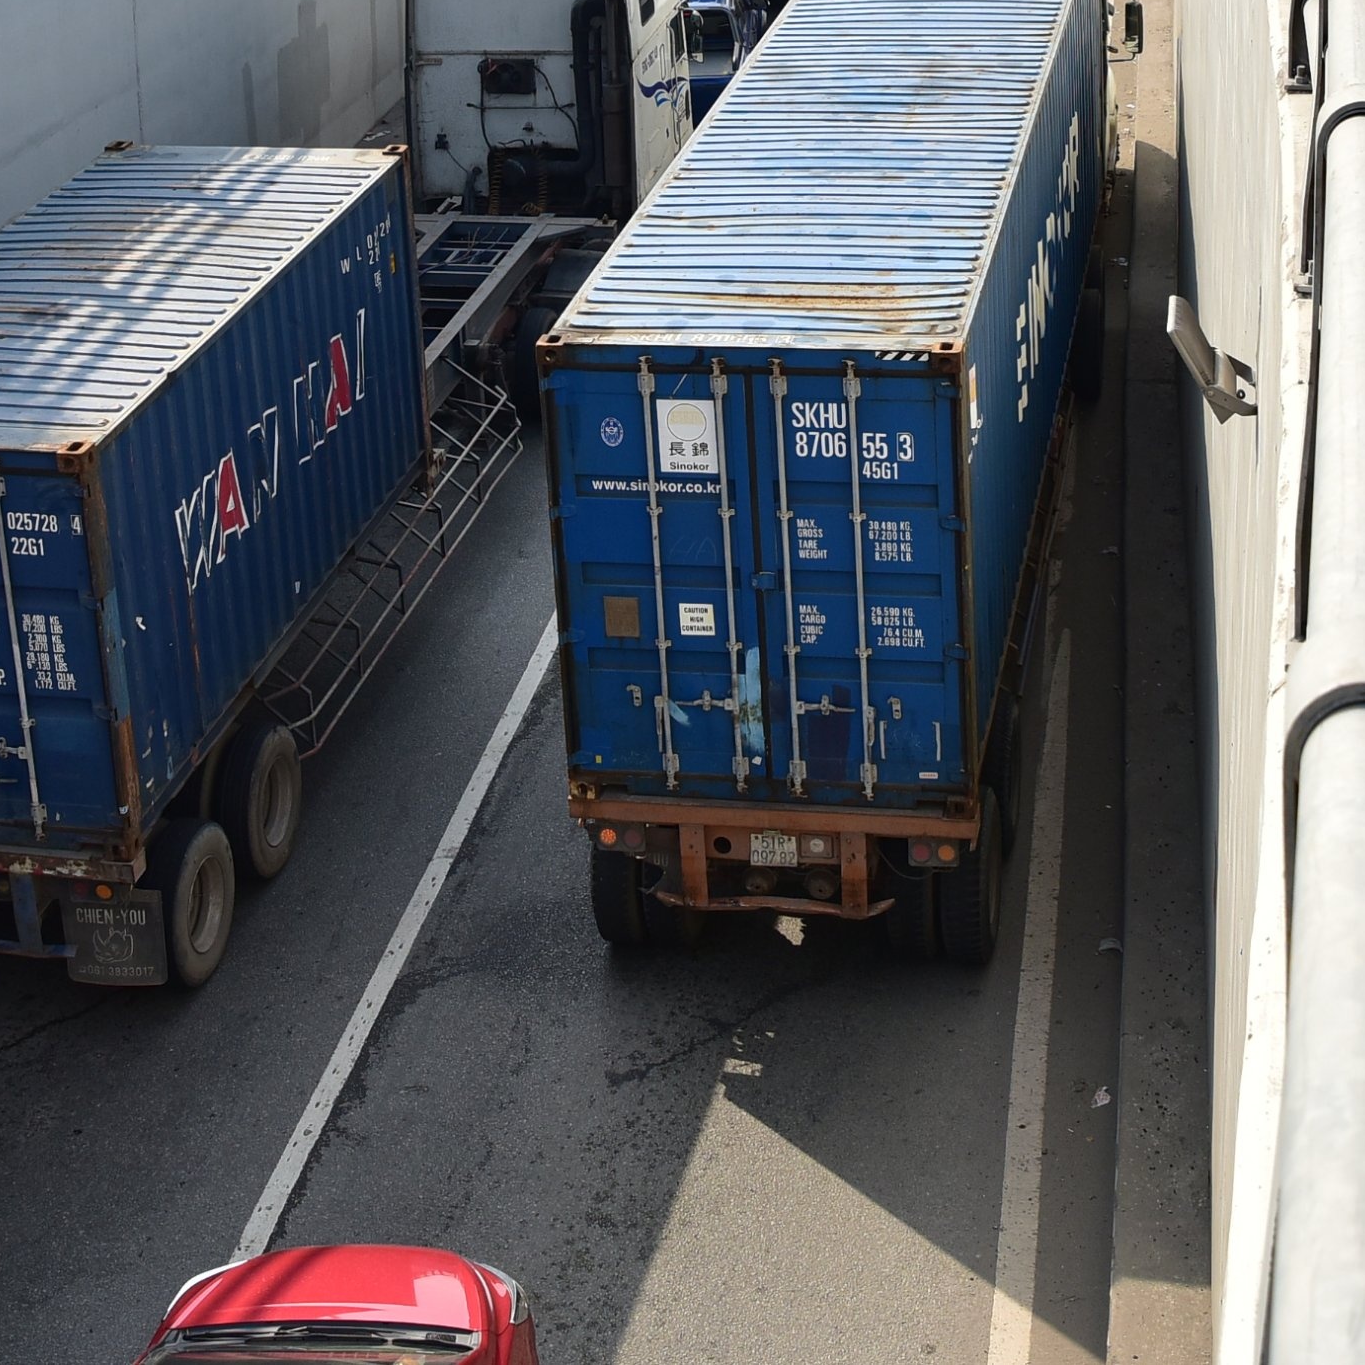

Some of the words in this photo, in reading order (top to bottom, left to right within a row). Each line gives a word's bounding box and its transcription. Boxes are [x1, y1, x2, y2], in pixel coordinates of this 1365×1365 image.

[791, 402, 847, 429] SKHU
[795, 431, 847, 458] 8706
[862, 432, 888, 459] 55
[899, 434, 912, 460] 3
[669, 461, 710, 472] Sinokor
[862, 461, 898, 480] 45G1
[6, 511, 59, 533] 025728
[796, 518, 818, 528] MAX.
[868, 521, 897, 531] 30.480
[900, 521, 913, 531] KG.
[797, 529, 823, 538] GROSS
[900, 532, 913, 541] LB.
[11, 537, 45, 556] 22G1
[798, 539, 818, 549] TARE
[900, 543, 913, 552] KG.
[798, 550, 828, 559] WEIGHT
[900, 553, 914, 562] LB.
[799, 605, 820, 615] MAX.
[902, 607, 916, 617] KG.
[49, 615, 59, 625] KG
[799, 614, 826, 624] CARGO
[903, 617, 916, 627] LB.
[51, 625, 63, 634] LBS
[800, 625, 824, 635] CUBIC
[52, 635, 62, 644] KG
[801, 635, 818, 644] CAP.
[53, 644, 66, 653] LBS
[54, 653, 64, 663] KG
[55, 663, 68, 672] LBS
[761, 836, 786, 850] 51R
[752, 849, 796, 866] 09782
[75, 907, 146, 925] CHIEN-YOU
